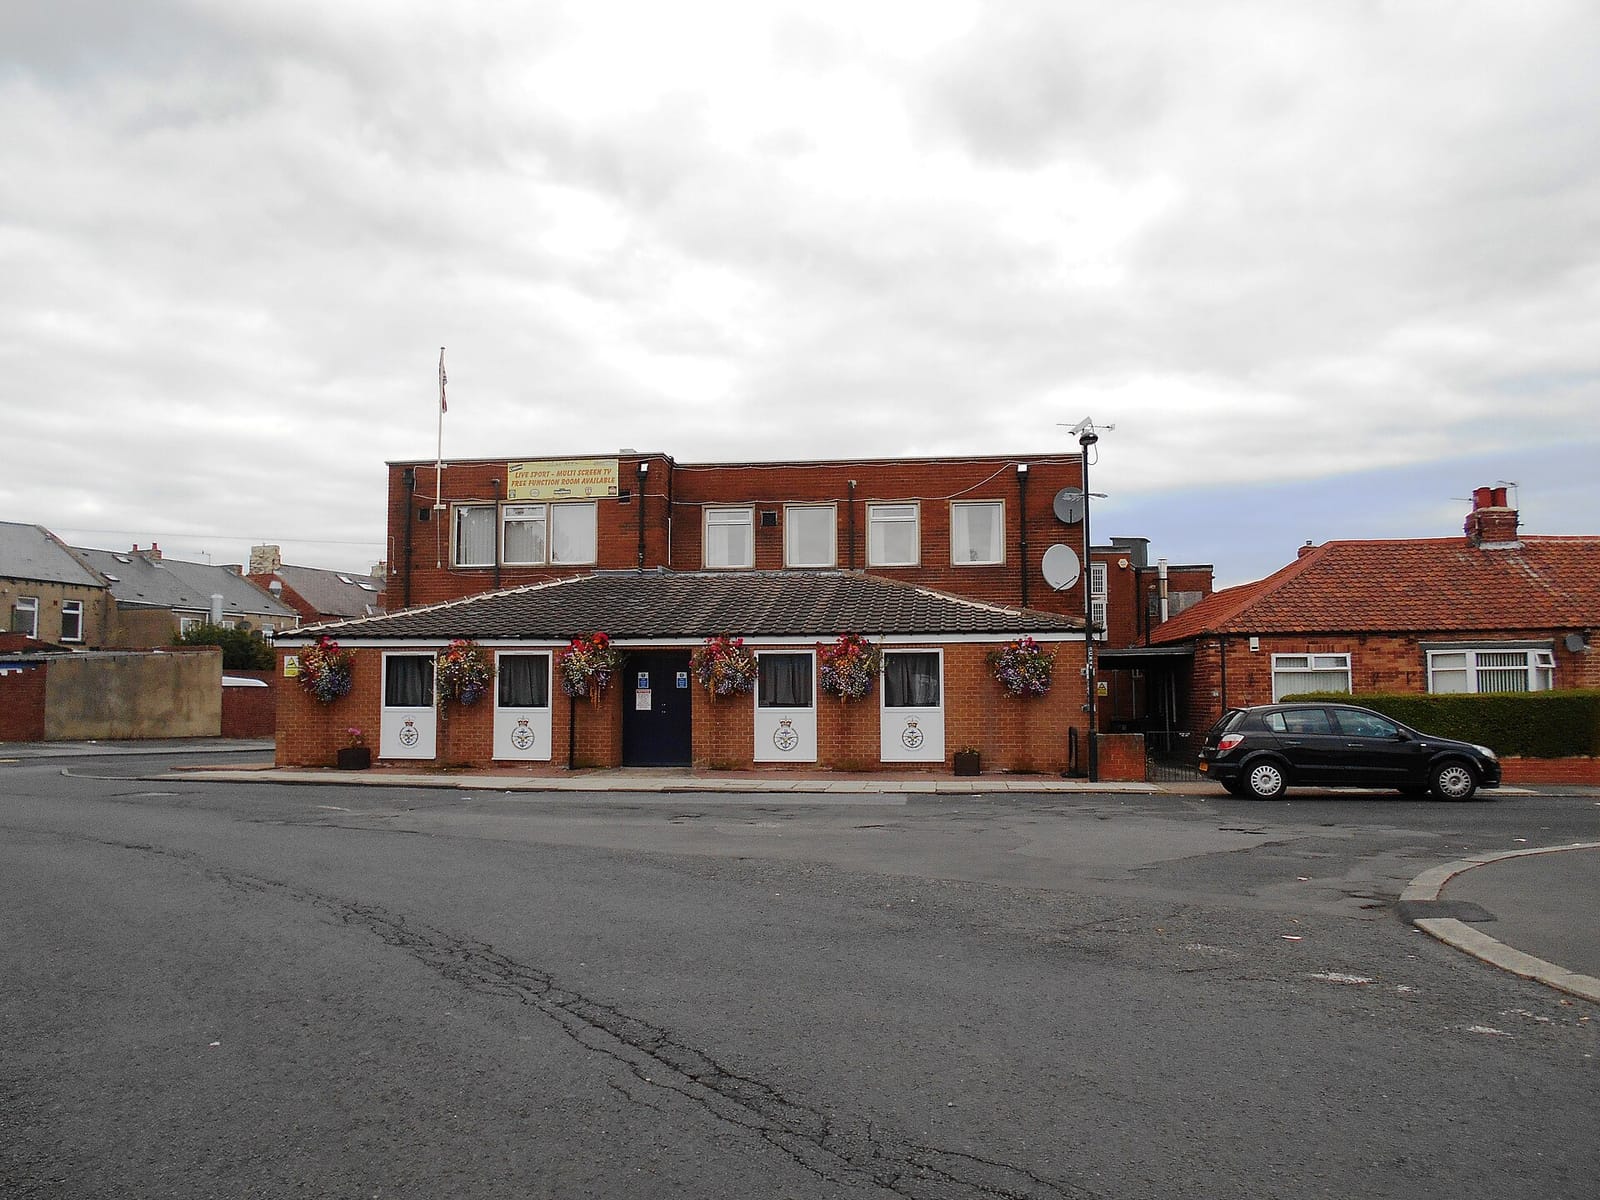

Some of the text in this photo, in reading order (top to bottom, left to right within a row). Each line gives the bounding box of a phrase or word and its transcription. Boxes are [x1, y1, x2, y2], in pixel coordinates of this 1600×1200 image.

[577, 469, 602, 477] SCREEN
[528, 479, 560, 487] FUNCTION
[561, 478, 580, 486] ROOM
[581, 477, 615, 485] AVAILABLE
